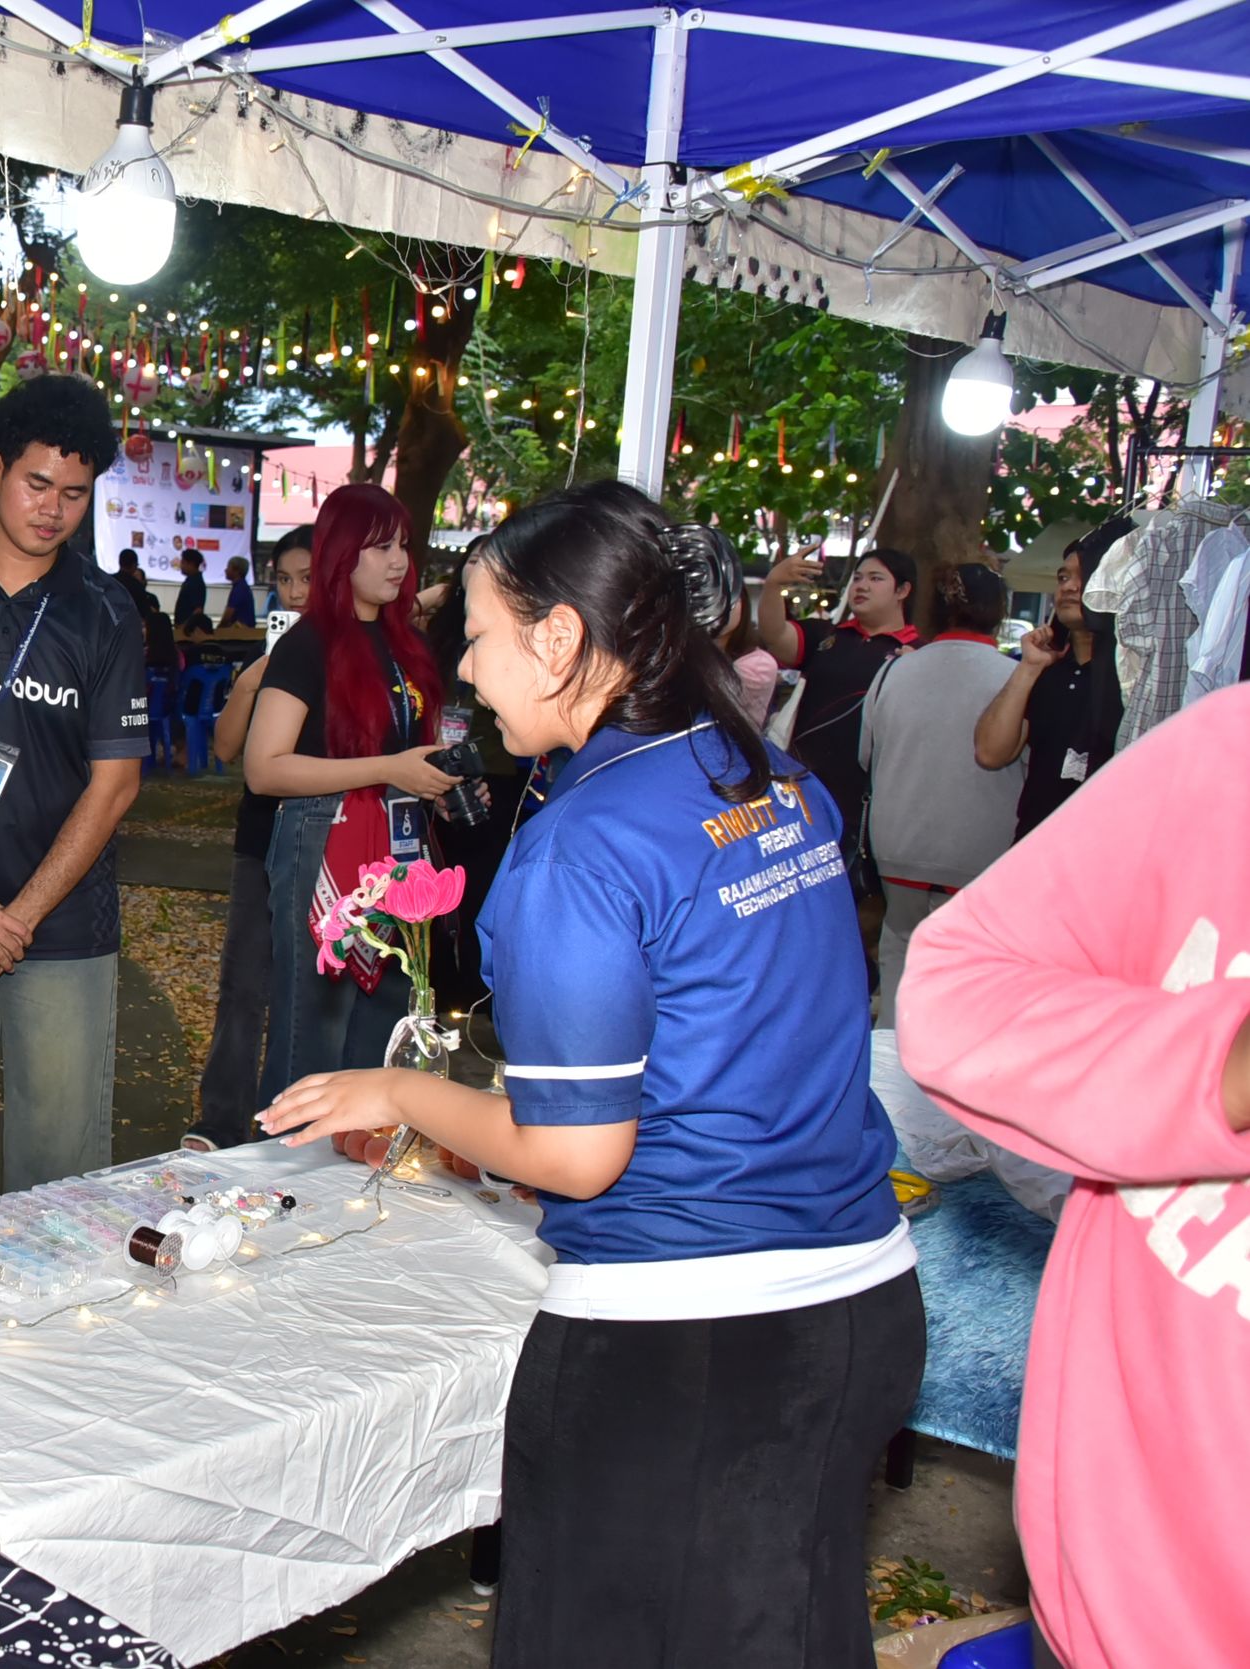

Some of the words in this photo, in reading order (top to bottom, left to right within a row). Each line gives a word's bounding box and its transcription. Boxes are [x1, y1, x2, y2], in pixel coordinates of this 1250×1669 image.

[701, 795, 779, 850] RMUTT
[756, 820, 806, 859] FRESHY
[717, 857, 799, 907] RAJAMANGALA
[733, 876, 801, 920] TECHNOLOGY
